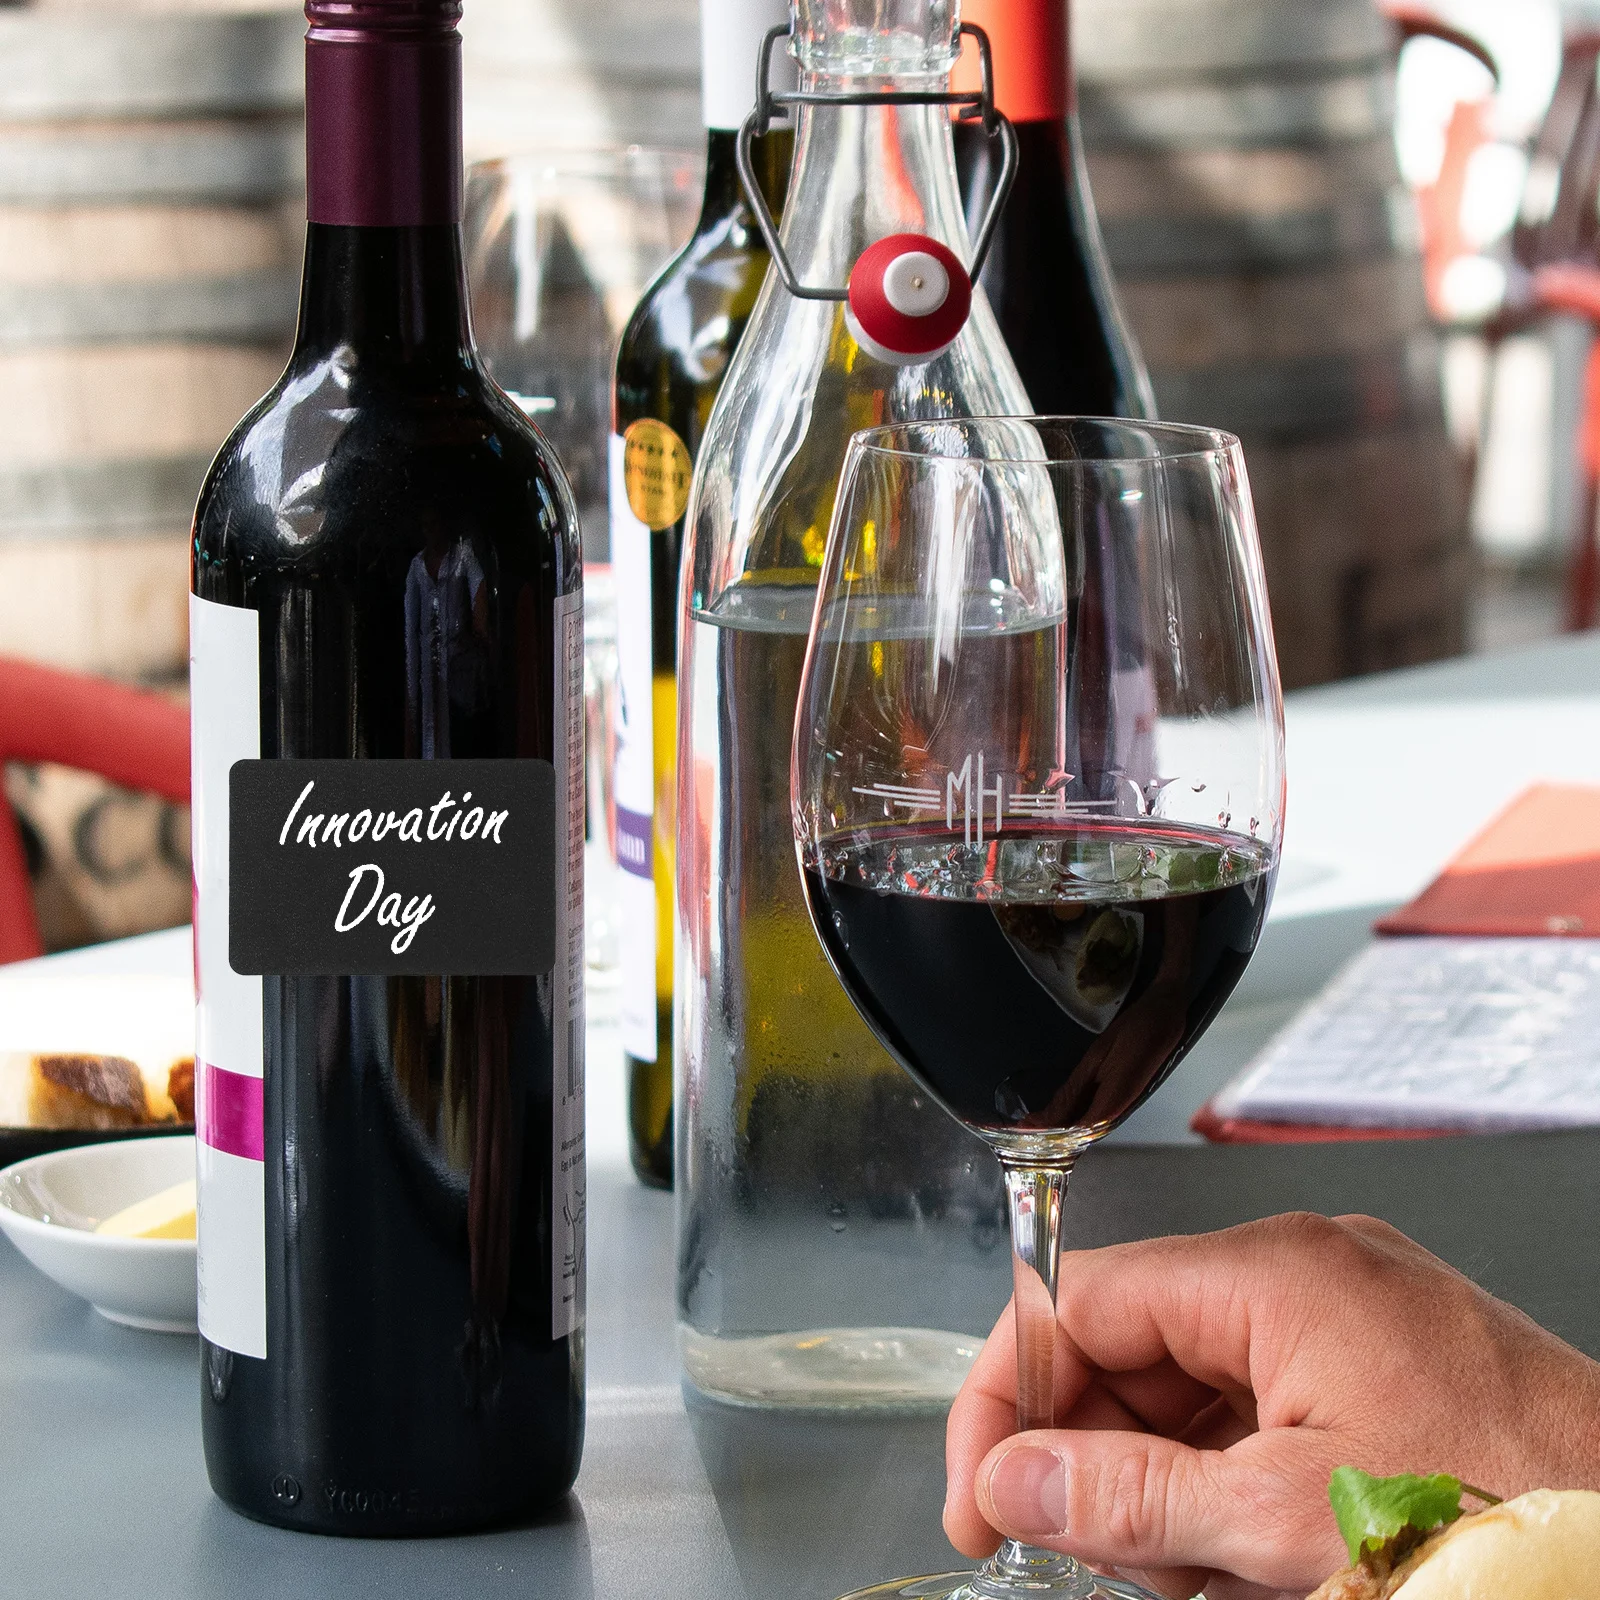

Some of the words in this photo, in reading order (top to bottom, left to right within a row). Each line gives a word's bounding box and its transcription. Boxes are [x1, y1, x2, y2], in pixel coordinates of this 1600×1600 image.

[278, 780, 510, 848] Innovation
[946, 749, 1003, 851] MH
[334, 863, 437, 955] Day
